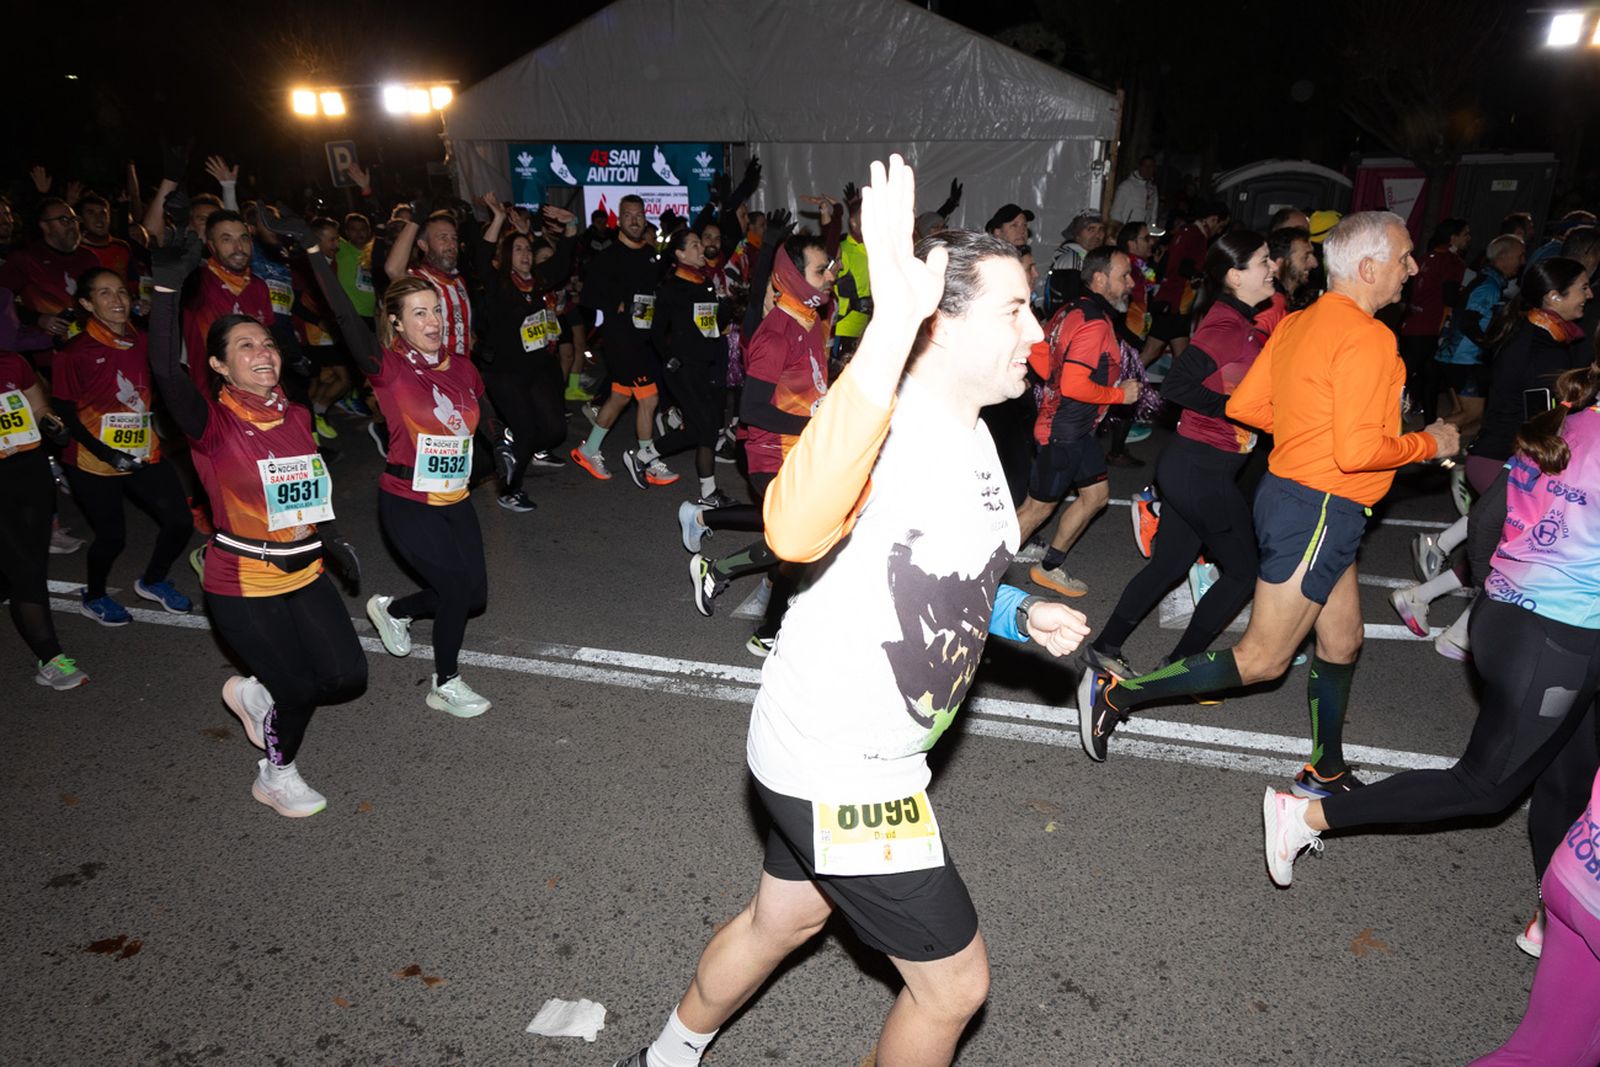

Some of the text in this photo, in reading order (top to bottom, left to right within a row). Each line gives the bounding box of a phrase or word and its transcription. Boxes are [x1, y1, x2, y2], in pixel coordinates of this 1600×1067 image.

[333, 146, 352, 173] P
[586, 163, 639, 183] ANTÓN
[643, 203, 661, 215] AN
[664, 203, 690, 215] ANT
[447, 415, 462, 431] 43
[113, 430, 145, 443] 8919
[278, 464, 298, 473] NOCHE
[300, 463, 308, 471] DE
[428, 456, 466, 473] 9532
[270, 475, 285, 484] SAN
[277, 479, 319, 504] 9531
[1546, 480, 1588, 505] Ceres
[837, 796, 920, 830] 8095
